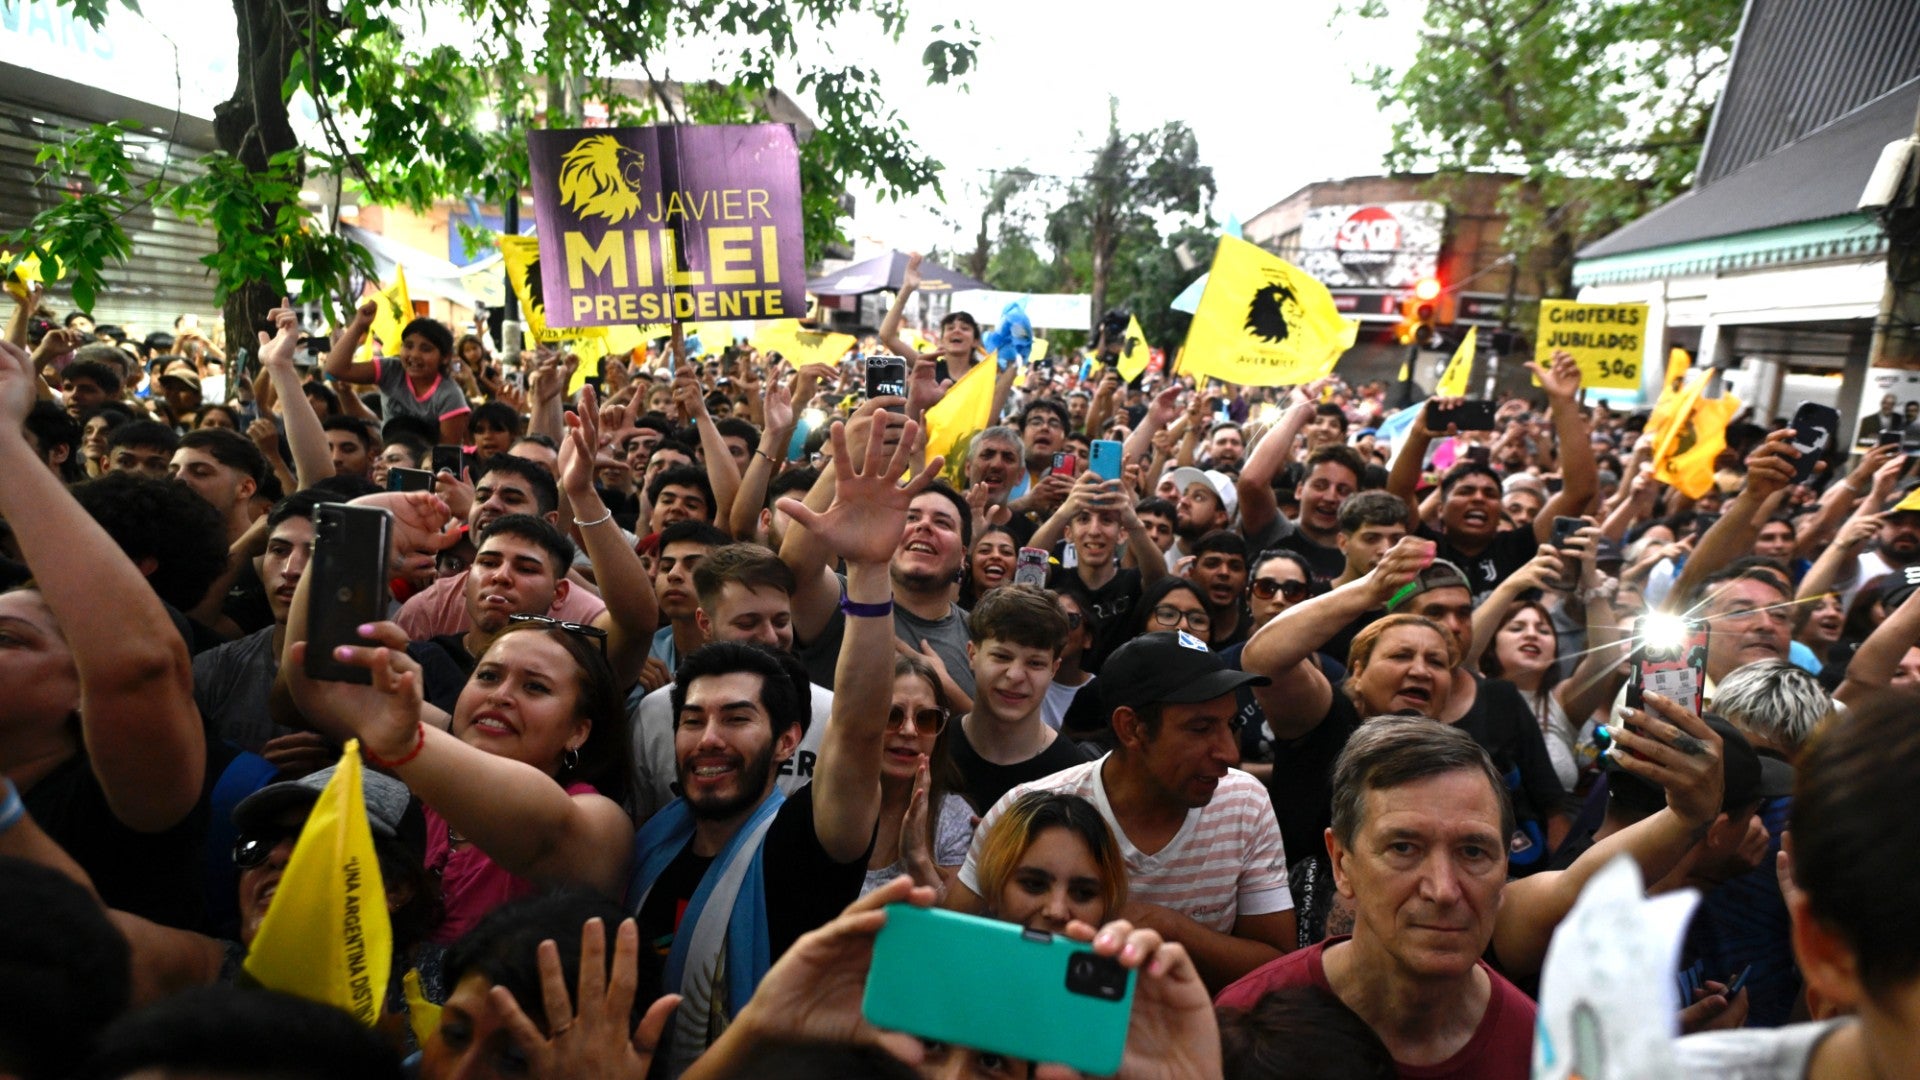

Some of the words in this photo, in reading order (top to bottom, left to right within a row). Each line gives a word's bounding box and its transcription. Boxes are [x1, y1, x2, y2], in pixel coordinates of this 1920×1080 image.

[647, 189, 771, 222] JAVIER
[564, 226, 780, 288] MILEI
[573, 290, 784, 321] PRESIDENTE
[1549, 307, 1639, 326] CHOFERES
[1547, 331, 1639, 351] JUBILADOS
[1598, 358, 1637, 379] 306
[344, 895, 367, 978] ARGENTINA
